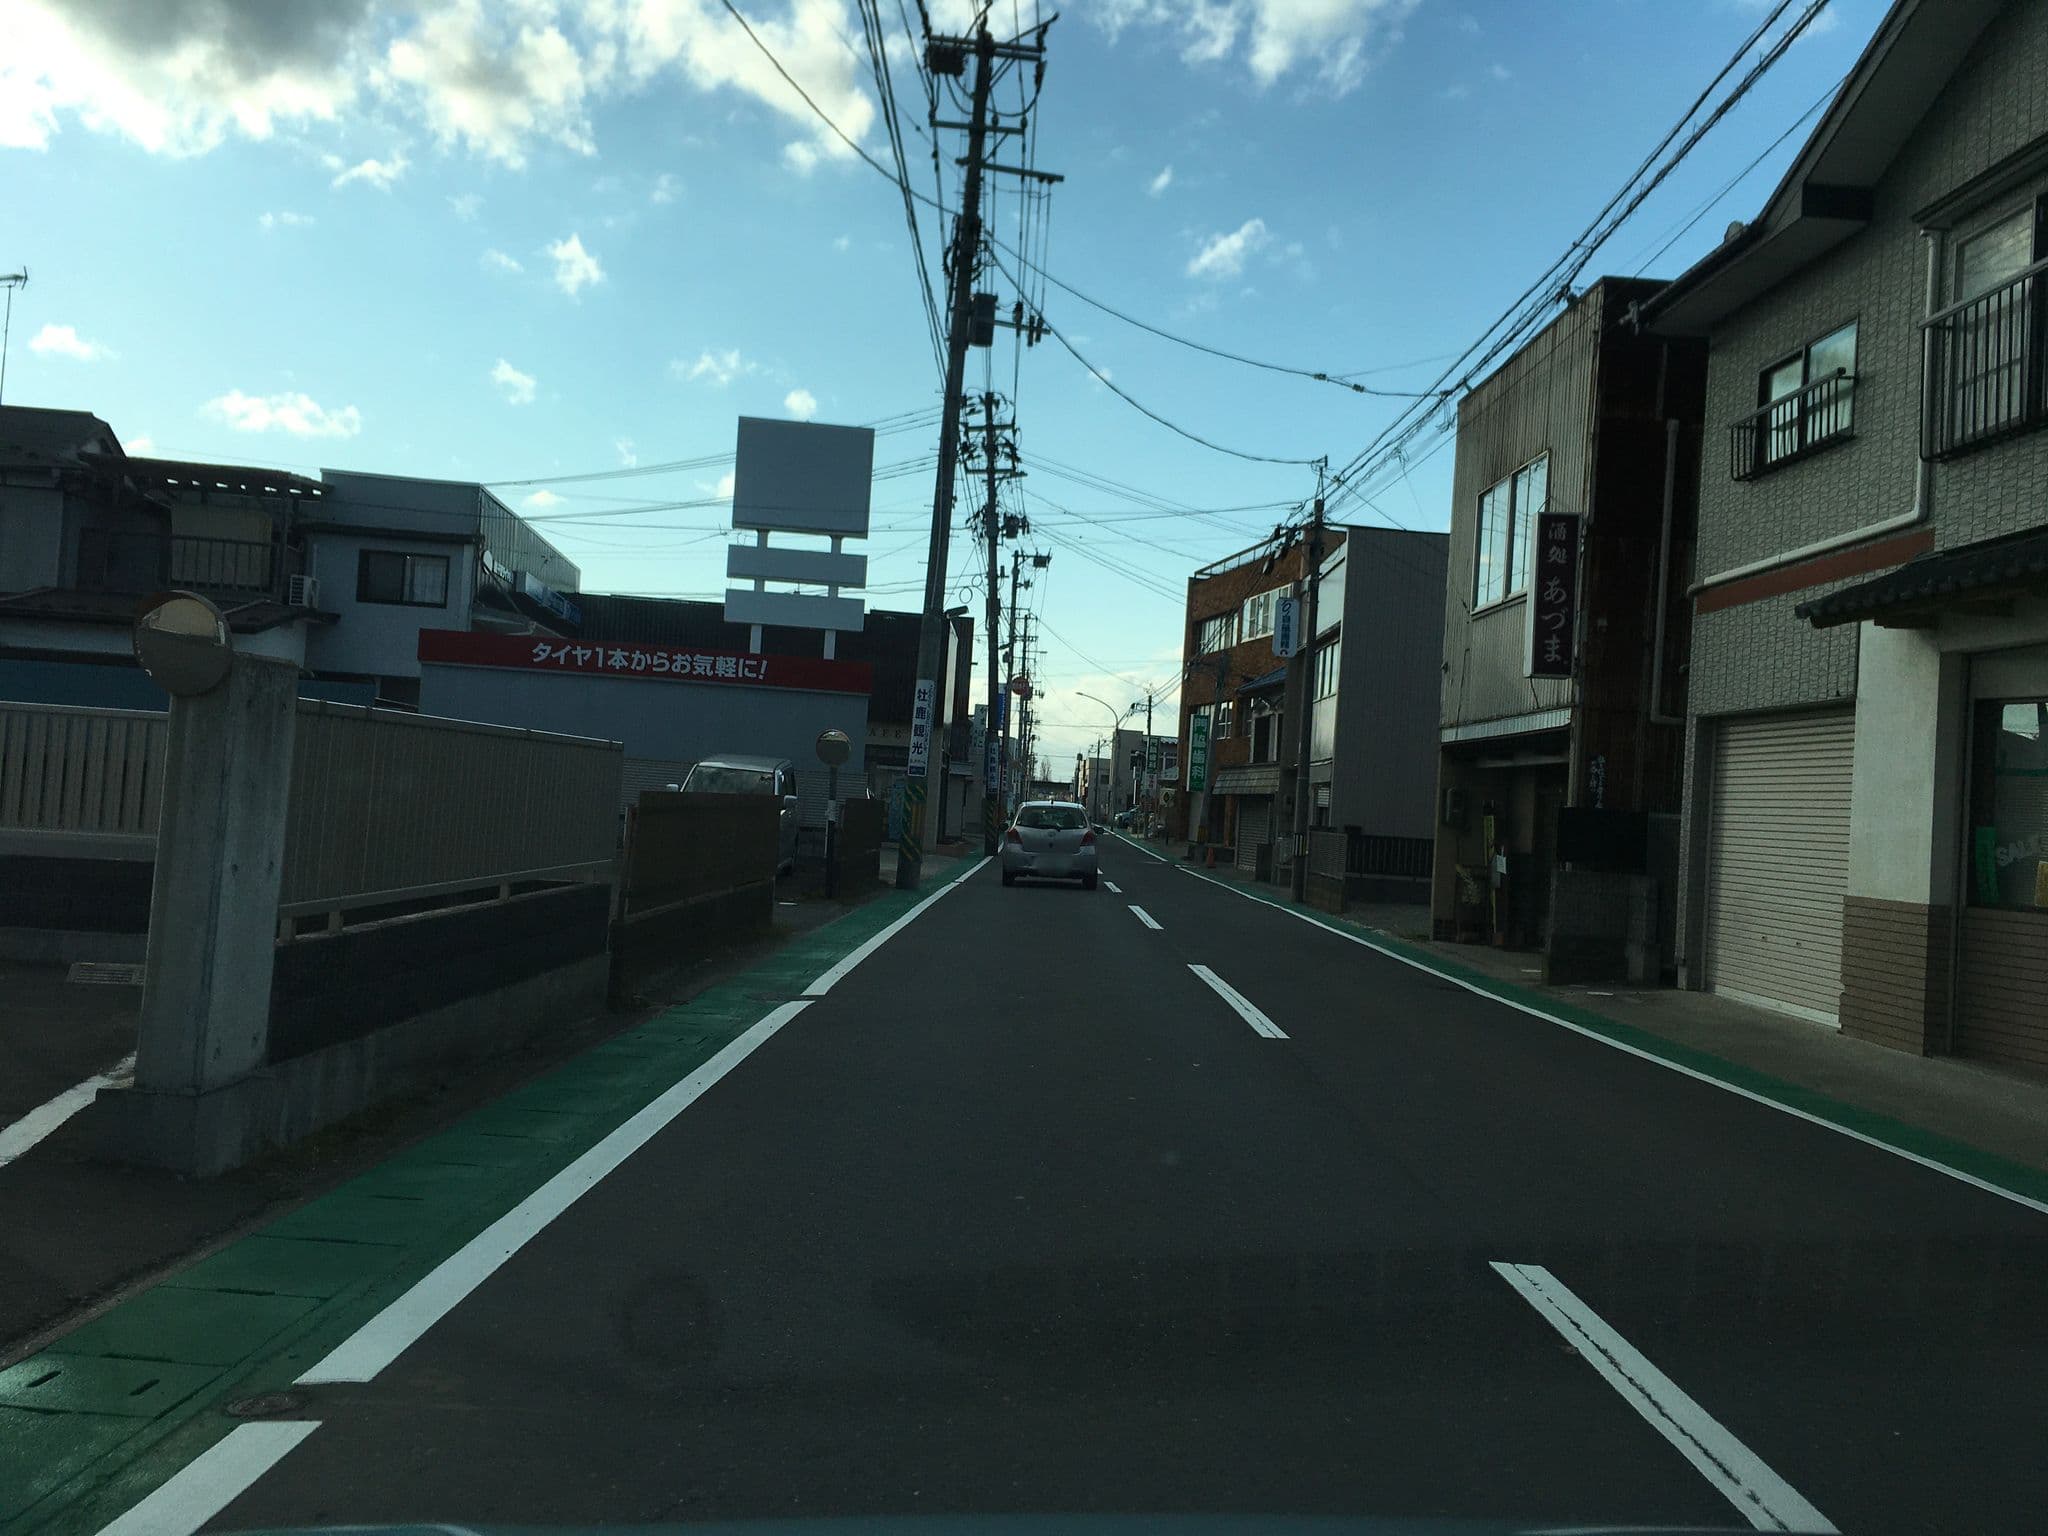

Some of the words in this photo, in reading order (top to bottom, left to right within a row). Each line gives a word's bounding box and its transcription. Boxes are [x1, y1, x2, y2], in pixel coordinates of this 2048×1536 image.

[1547, 522, 1568, 564] 酒処
[1541, 576, 1568, 661] あづま
[532, 642, 767, 680] タイヤ1本からお気軽に!
